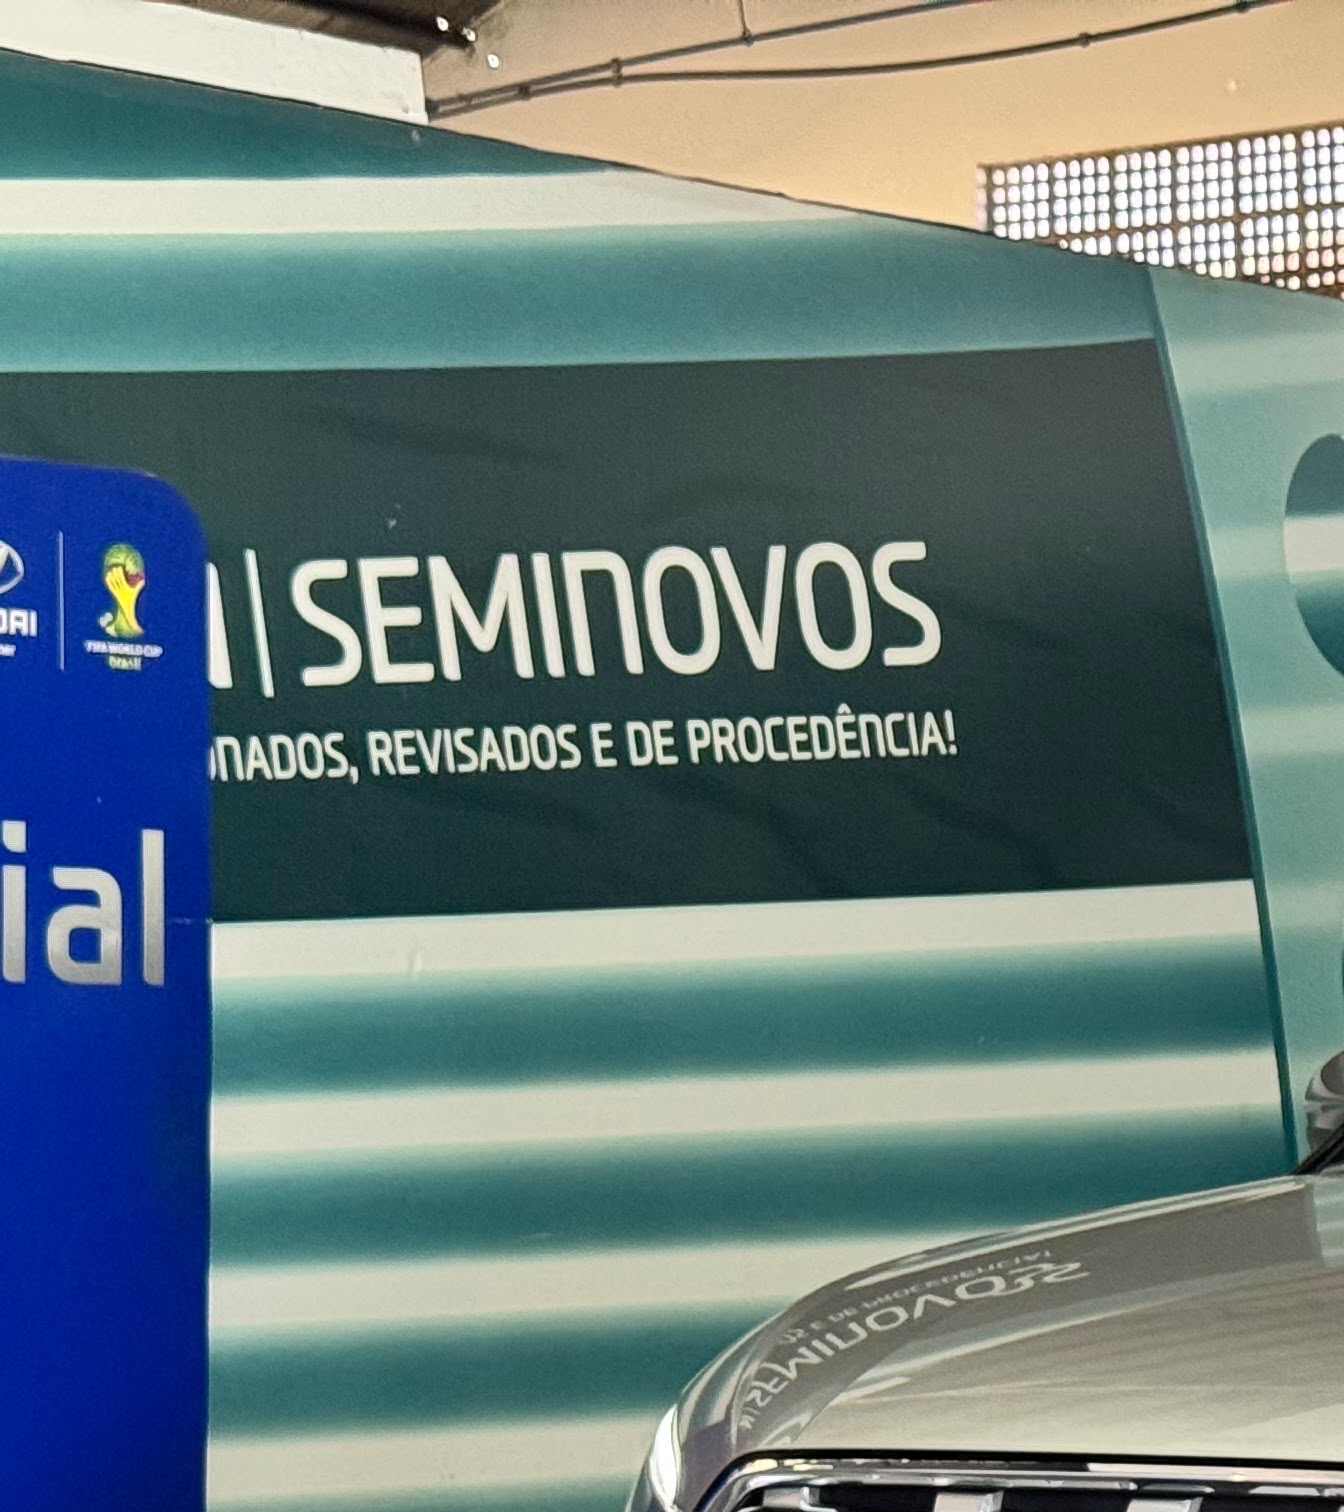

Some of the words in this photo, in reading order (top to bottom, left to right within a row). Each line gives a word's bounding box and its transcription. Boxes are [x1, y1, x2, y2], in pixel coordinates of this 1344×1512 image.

[291, 541, 942, 687] SEMINOVOS
[367, 723, 582, 776] REVISADOS
[590, 722, 618, 768] E
[626, 720, 679, 766] DE
[686, 703, 958, 764] PROCEDÊNCIA!
